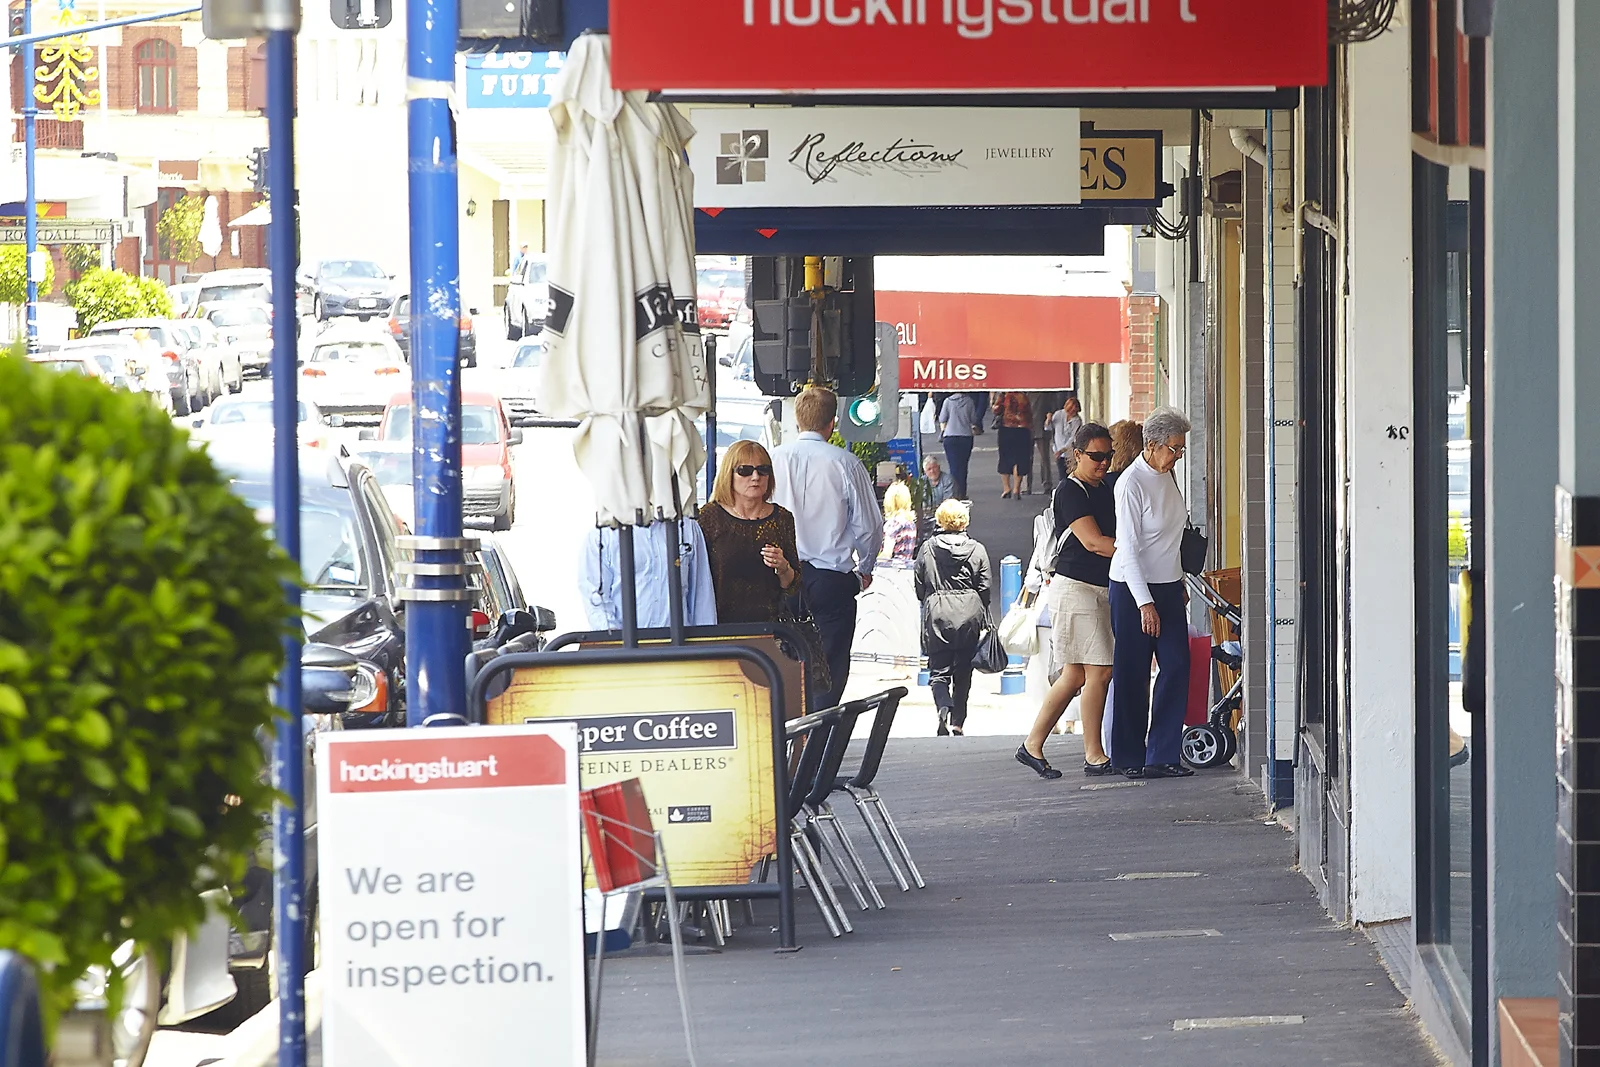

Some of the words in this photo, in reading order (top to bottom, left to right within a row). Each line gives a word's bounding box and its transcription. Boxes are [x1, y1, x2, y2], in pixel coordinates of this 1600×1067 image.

[789, 132, 964, 185] Reflections
[985, 147, 1054, 160] JEWELLERY
[5, 229, 81, 241] ROKDALE
[913, 359, 988, 380] Miles
[633, 715, 718, 742] Coffee
[340, 754, 499, 784] hockingstuart
[345, 867, 402, 894] We
[417, 871, 475, 893] are
[347, 917, 440, 948] open
[453, 911, 505, 938] for
[347, 956, 554, 993] inspection.
